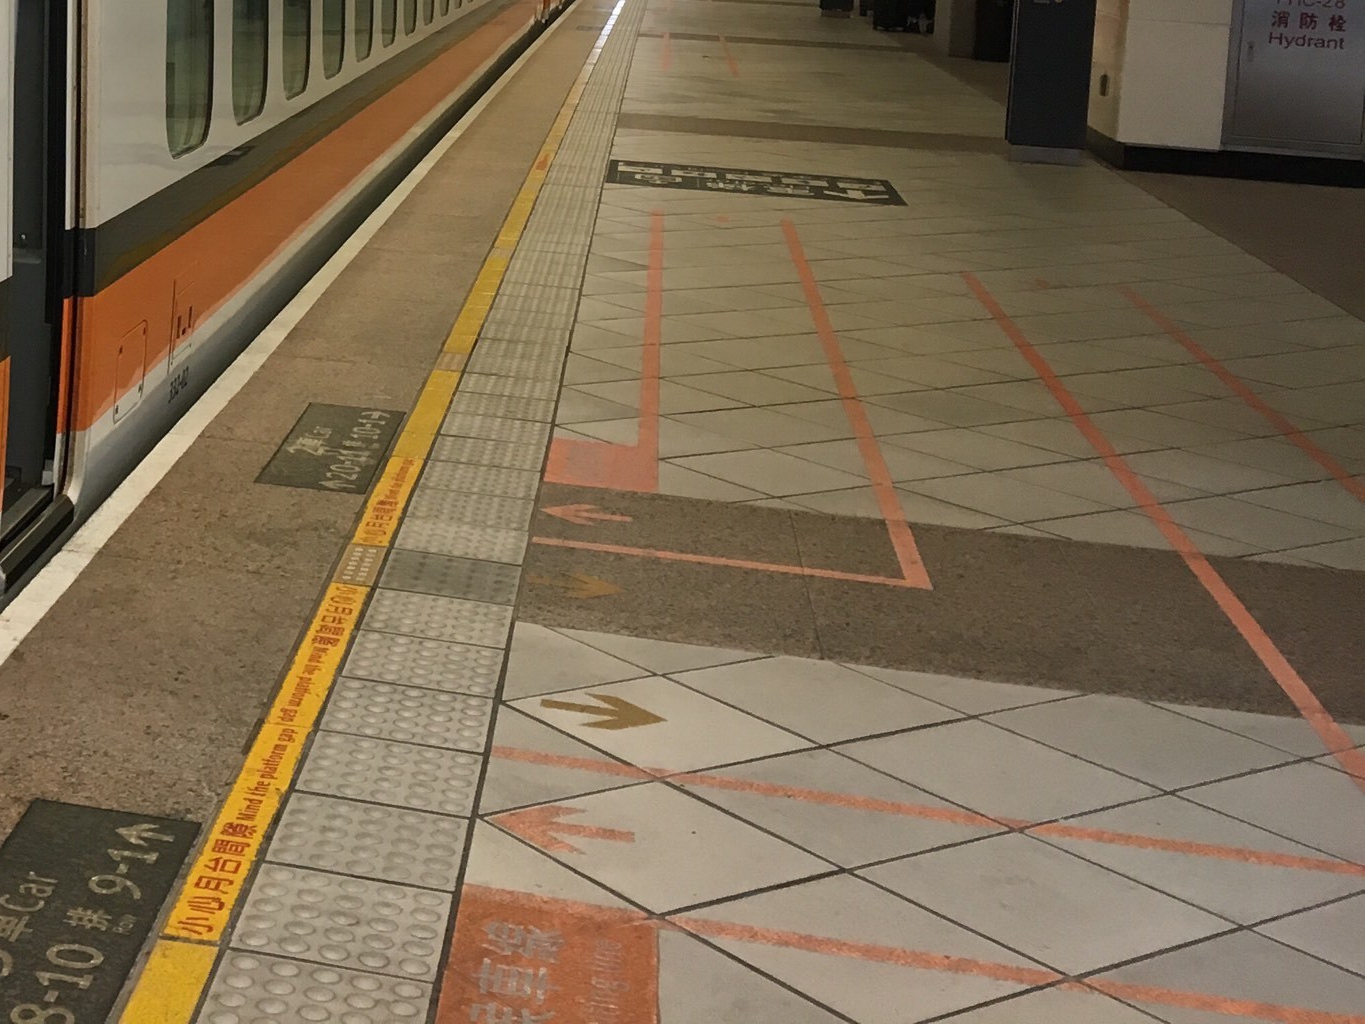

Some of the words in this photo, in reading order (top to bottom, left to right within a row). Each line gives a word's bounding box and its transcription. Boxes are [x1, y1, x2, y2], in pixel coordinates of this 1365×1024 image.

[1271, 10, 1346, 33] 消防栓
[1268, 32, 1345, 51] Hydrant
[307, 645, 330, 664] Mind
[301, 662, 322, 676] the
[287, 675, 315, 708] platform
[277, 707, 298, 723] gap
[277, 727, 299, 744] gap
[256, 743, 289, 780] platform
[245, 780, 271, 797] the
[235, 797, 264, 823] Mind
[87, 848, 160, 901] 9-1
[177, 821, 258, 936] 小心月台間隙
